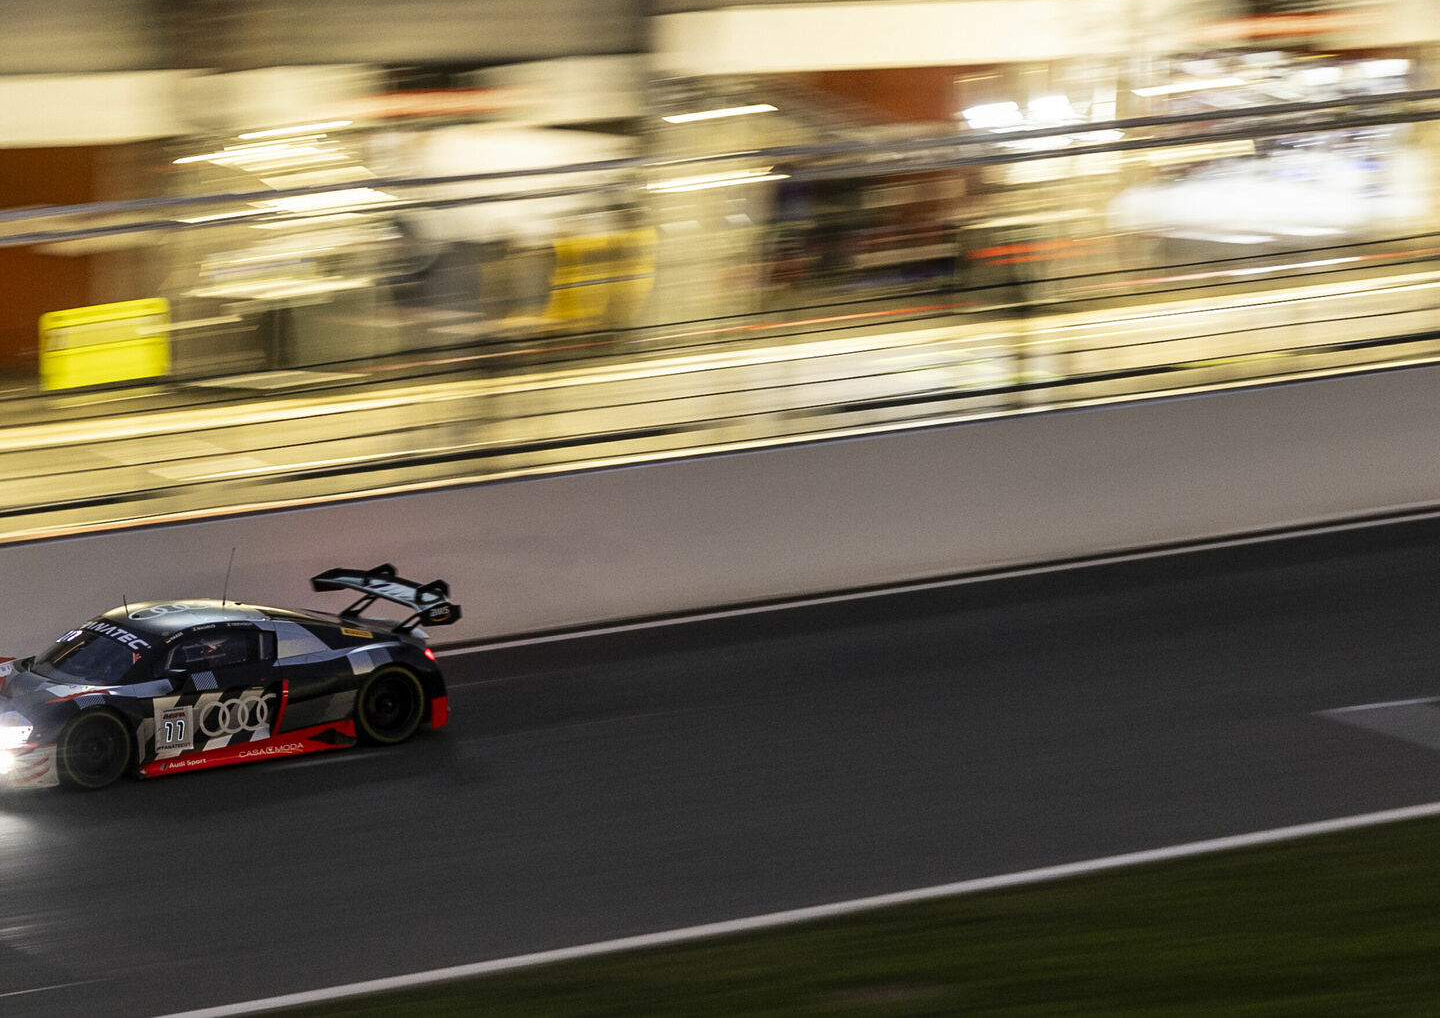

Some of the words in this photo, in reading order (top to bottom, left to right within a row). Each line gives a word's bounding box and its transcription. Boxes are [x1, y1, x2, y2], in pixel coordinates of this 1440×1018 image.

[164, 719, 186, 743] 11
[238, 749, 266, 758] CASA
[275, 743, 304, 753] MODA
[187, 758, 207, 767] Sport
